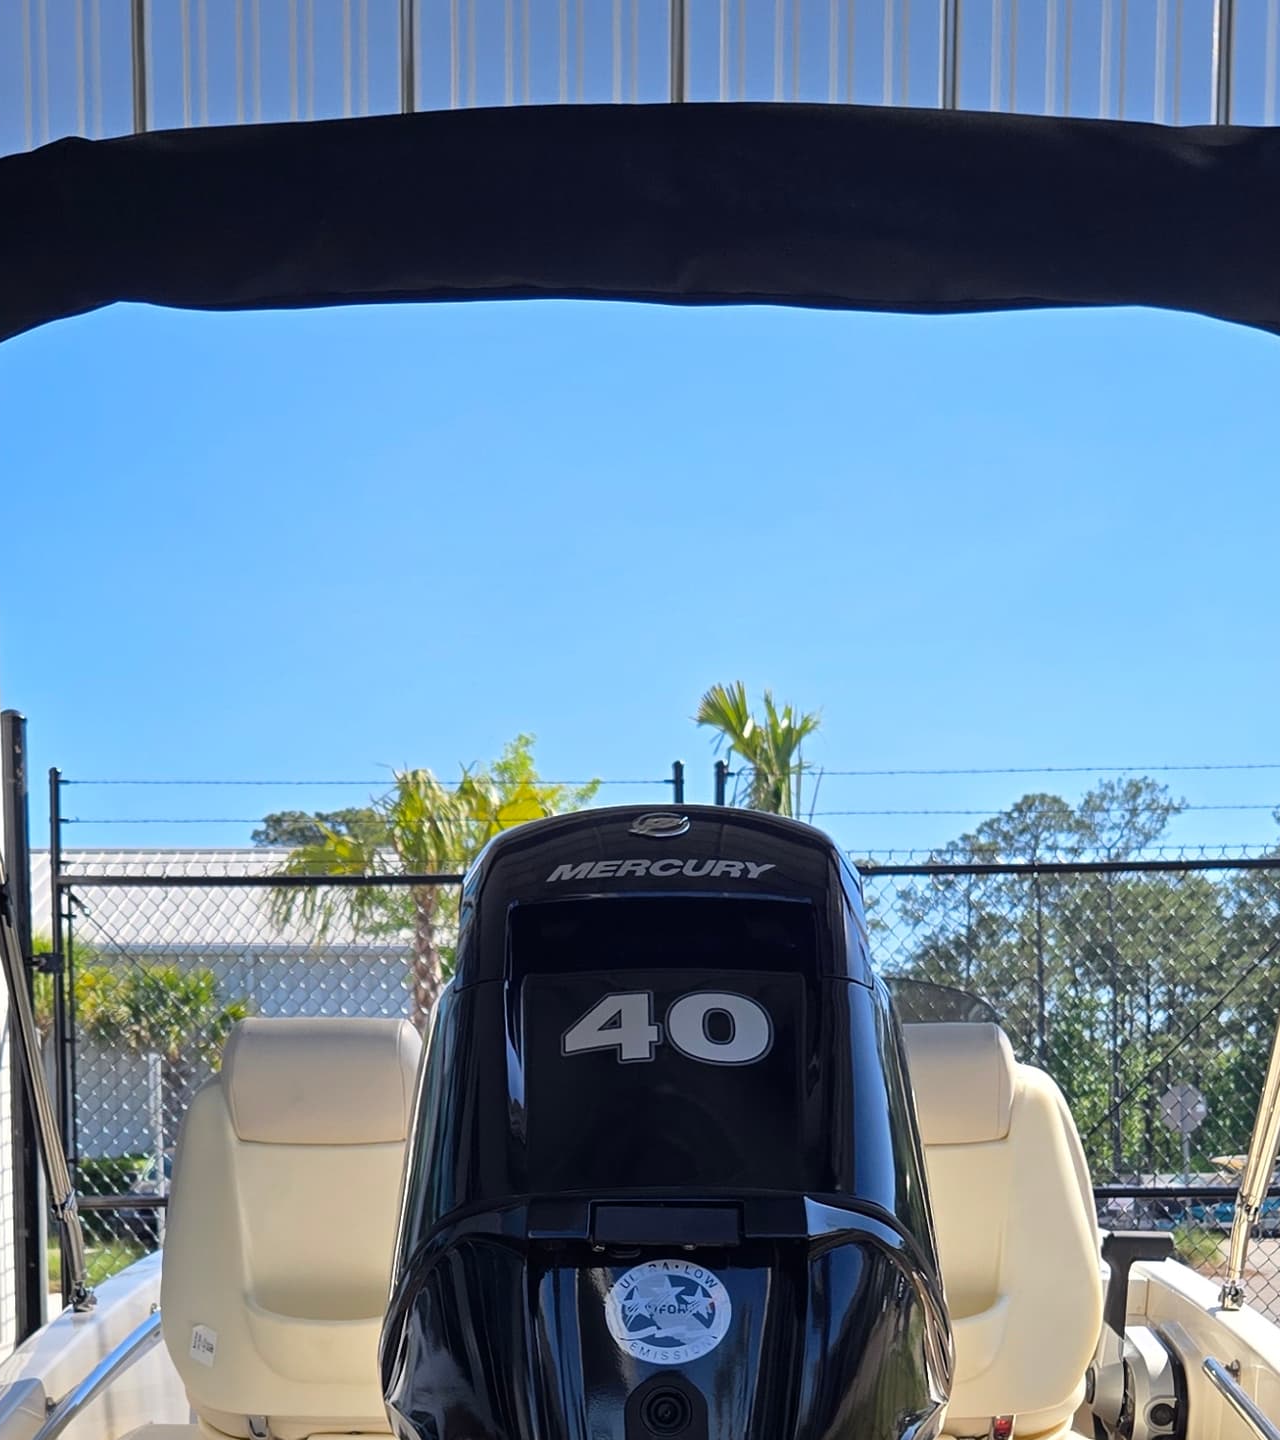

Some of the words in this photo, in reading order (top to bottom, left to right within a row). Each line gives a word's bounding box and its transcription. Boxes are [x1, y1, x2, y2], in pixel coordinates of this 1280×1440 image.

[546, 858, 776, 882] MERCURY
[561, 990, 774, 1066] 40
[685, 1264, 718, 1289] LOW
